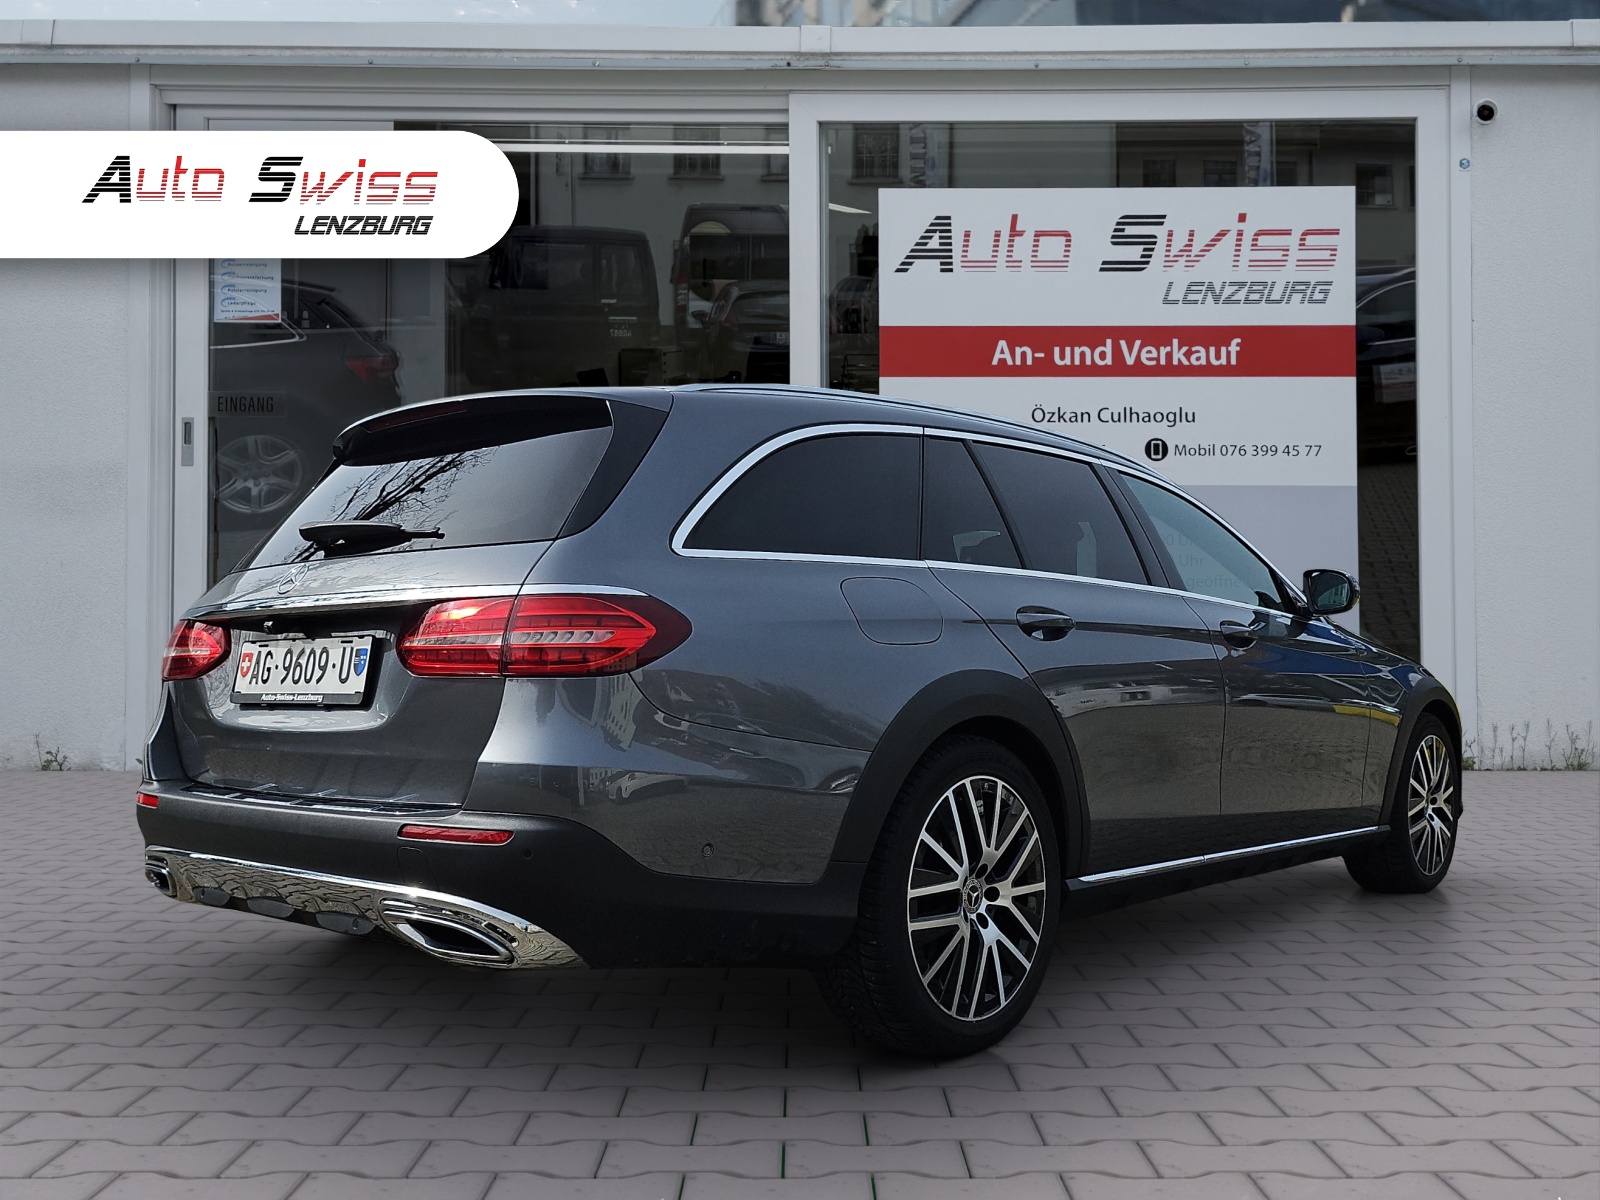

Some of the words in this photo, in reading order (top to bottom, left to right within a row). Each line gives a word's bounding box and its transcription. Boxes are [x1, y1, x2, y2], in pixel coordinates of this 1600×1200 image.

[894, 213, 1072, 273] Auto
[1098, 212, 1341, 272] Swiss
[1162, 280, 1333, 305] LENZBURG
[991, 339, 1045, 366] An-
[1053, 338, 1112, 367] und
[1119, 338, 1242, 367] Verkauf
[217, 396, 274, 412] EINGANG
[1031, 404, 1091, 423] Özkan
[1097, 406, 1196, 427] Culhaoglu
[1173, 443, 1216, 457] Mobil
[1220, 444, 1247, 457] 076
[1251, 444, 1278, 457] 399
[1282, 444, 1300, 457] 45
[1305, 444, 1322, 457] 77
[1179, 553, 1205, 567] Uhr
[1186, 574, 1246, 591] geöffne
[260, 693, 324, 702] Auto-Swiss-Lenzburg
